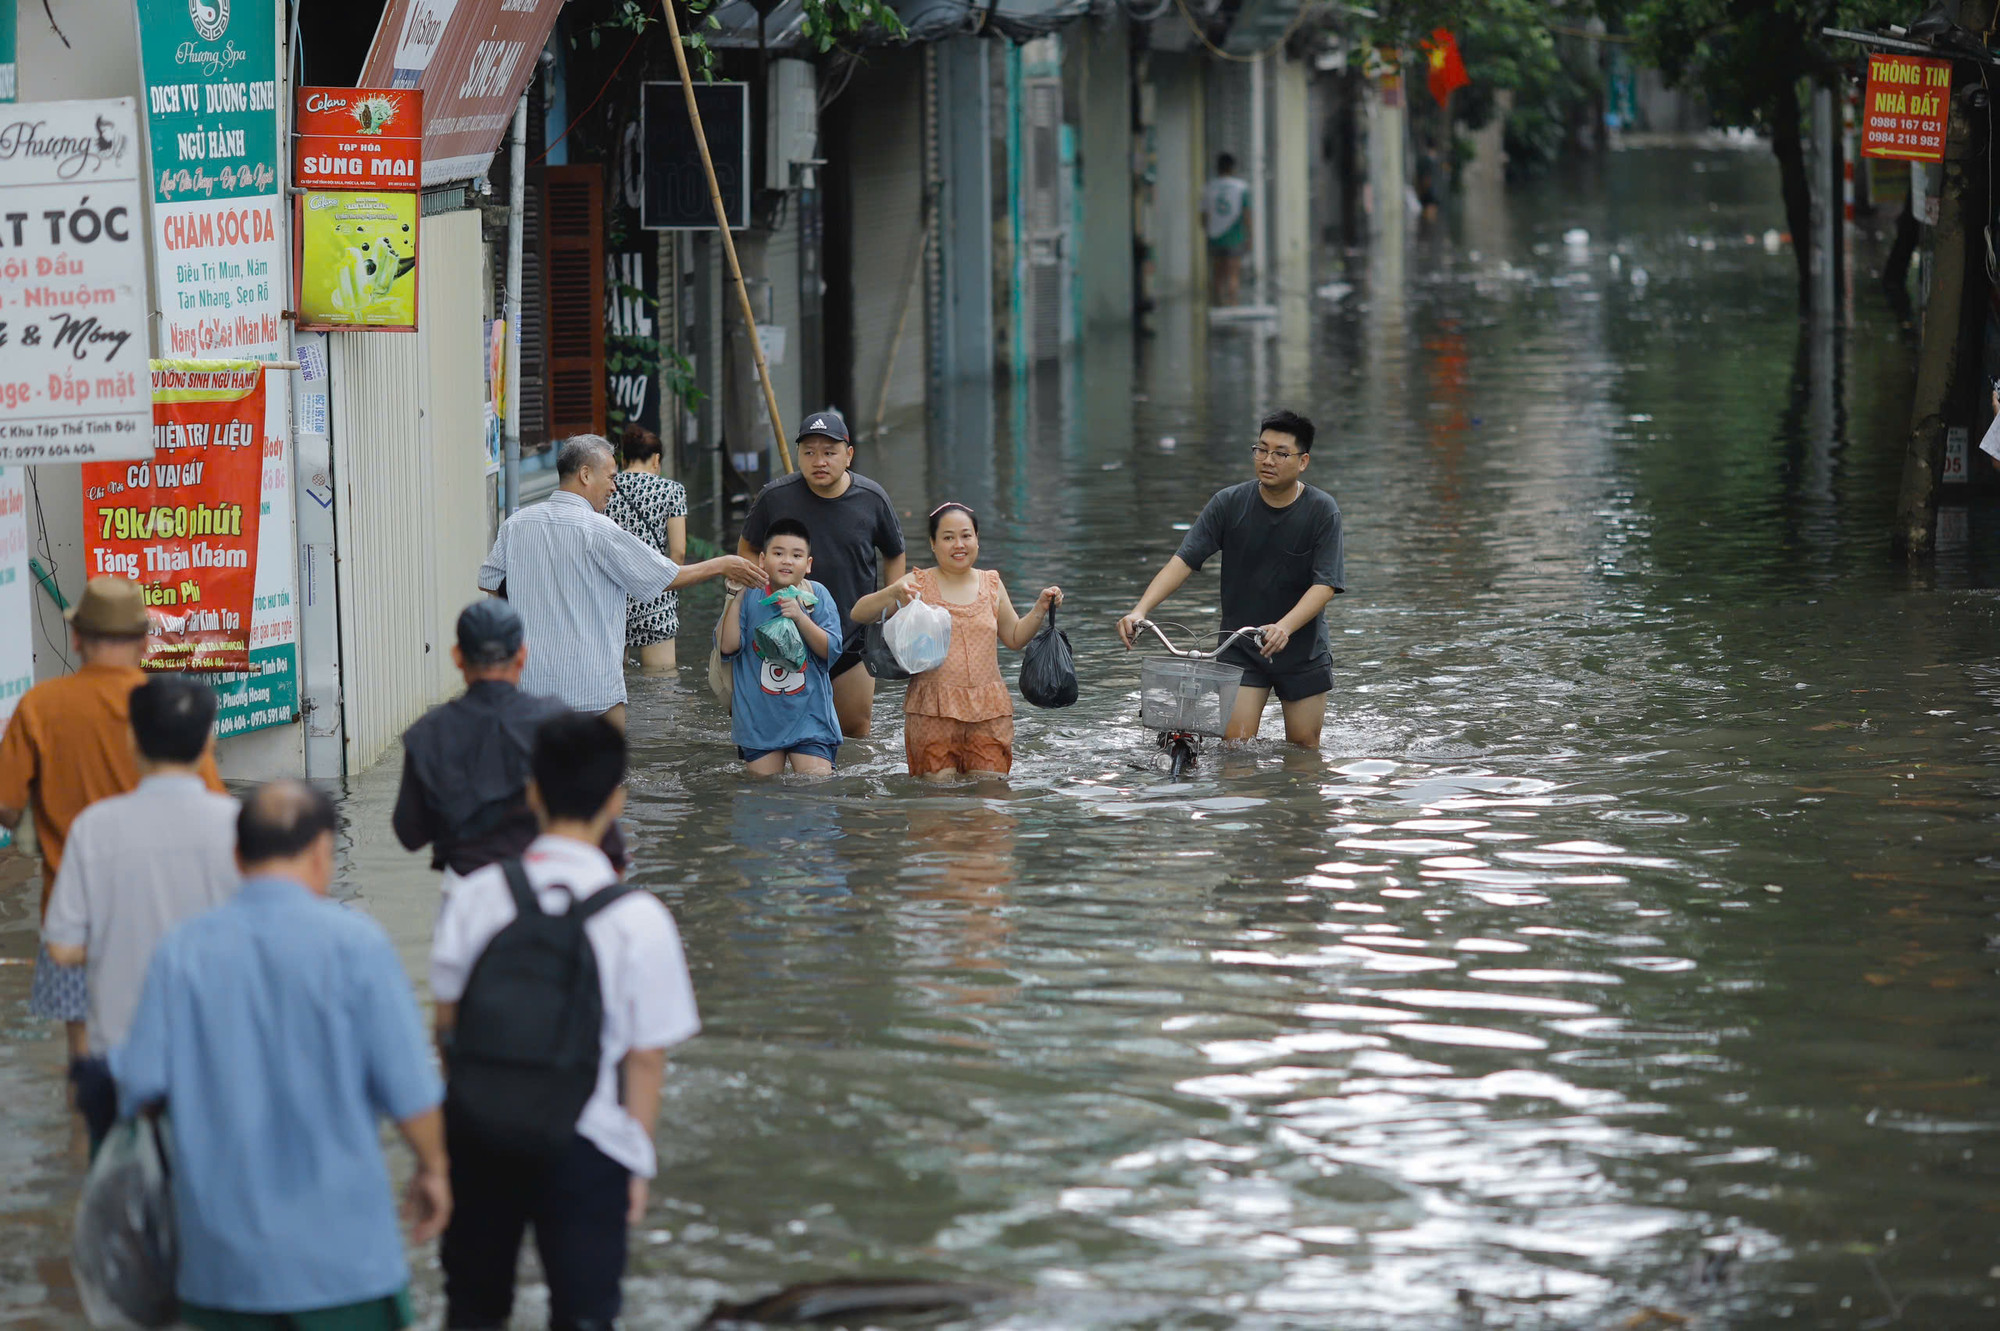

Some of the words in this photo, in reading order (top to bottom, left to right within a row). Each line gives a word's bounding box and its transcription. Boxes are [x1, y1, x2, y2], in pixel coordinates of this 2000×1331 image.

[175, 41, 224, 76] Phượng
[222, 40, 246, 72] Spa
[1872, 60, 1920, 85] THÔNG
[1925, 67, 1950, 87] TIN
[151, 86, 180, 119] DỊCH
[181, 84, 199, 117] VỤ
[249, 81, 275, 111] SINH
[306, 93, 347, 112] Celano
[1875, 90, 1906, 114] NHÀ
[1910, 90, 1940, 117] ĐẤT
[1870, 117, 1897, 128] 0986
[1900, 119, 1919, 130] 167
[1922, 120, 1941, 132] 621
[0, 121, 101, 179] Phượng
[177, 124, 206, 160] NGŨ
[208, 123, 246, 158] HÀNH
[338, 144, 357, 152] TẠP
[361, 143, 381, 152] HÓA
[1868, 131, 1895, 143] 0984
[1897, 133, 1917, 145] 218
[1920, 135, 1940, 147] 982
[304, 152, 363, 175] SÙNG
[371, 159, 414, 176] MAI
[0, 213, 28, 247] T
[43, 195, 129, 244] TÓC
[164, 212, 214, 251] CHĂM
[217, 207, 249, 247] SÓC
[253, 208, 275, 242] DA
[0, 257, 28, 283] ội
[36, 252, 83, 278] Đầu
[177, 262, 199, 283] Điều
[202, 263, 216, 283] Trị
[219, 261, 244, 282] Mụn,
[247, 259, 268, 276] Nám
[25, 284, 116, 309] Nhuộm
[178, 292, 195, 309] Tàn
[237, 286, 254, 306] Sẹo
[21, 325, 42, 346] &
[49, 313, 131, 362] Móng
[262, 313, 278, 346] Mặt
[48, 365, 90, 406] Đắp
[96, 371, 136, 404] mặt
[188, 373, 210, 389] SINH
[211, 370, 230, 389] NGŨ
[10, 425, 33, 438] Khu
[186, 423, 210, 450] TRỊ
[213, 419, 253, 451] LIỆU
[16, 446, 45, 458] 0979
[264, 435, 284, 461] Body
[155, 465, 181, 487] VAI
[182, 458, 204, 486] GÁY
[94, 547, 140, 580] Tặng
[192, 541, 247, 568] Khám
[139, 580, 177, 606] iễn
[180, 579, 200, 604] Phí
[200, 608, 219, 631] Kinh
[221, 608, 239, 634] Tọa
[220, 717, 234, 734] 604
[251, 709, 267, 727] 0974
[268, 707, 278, 724] 591
